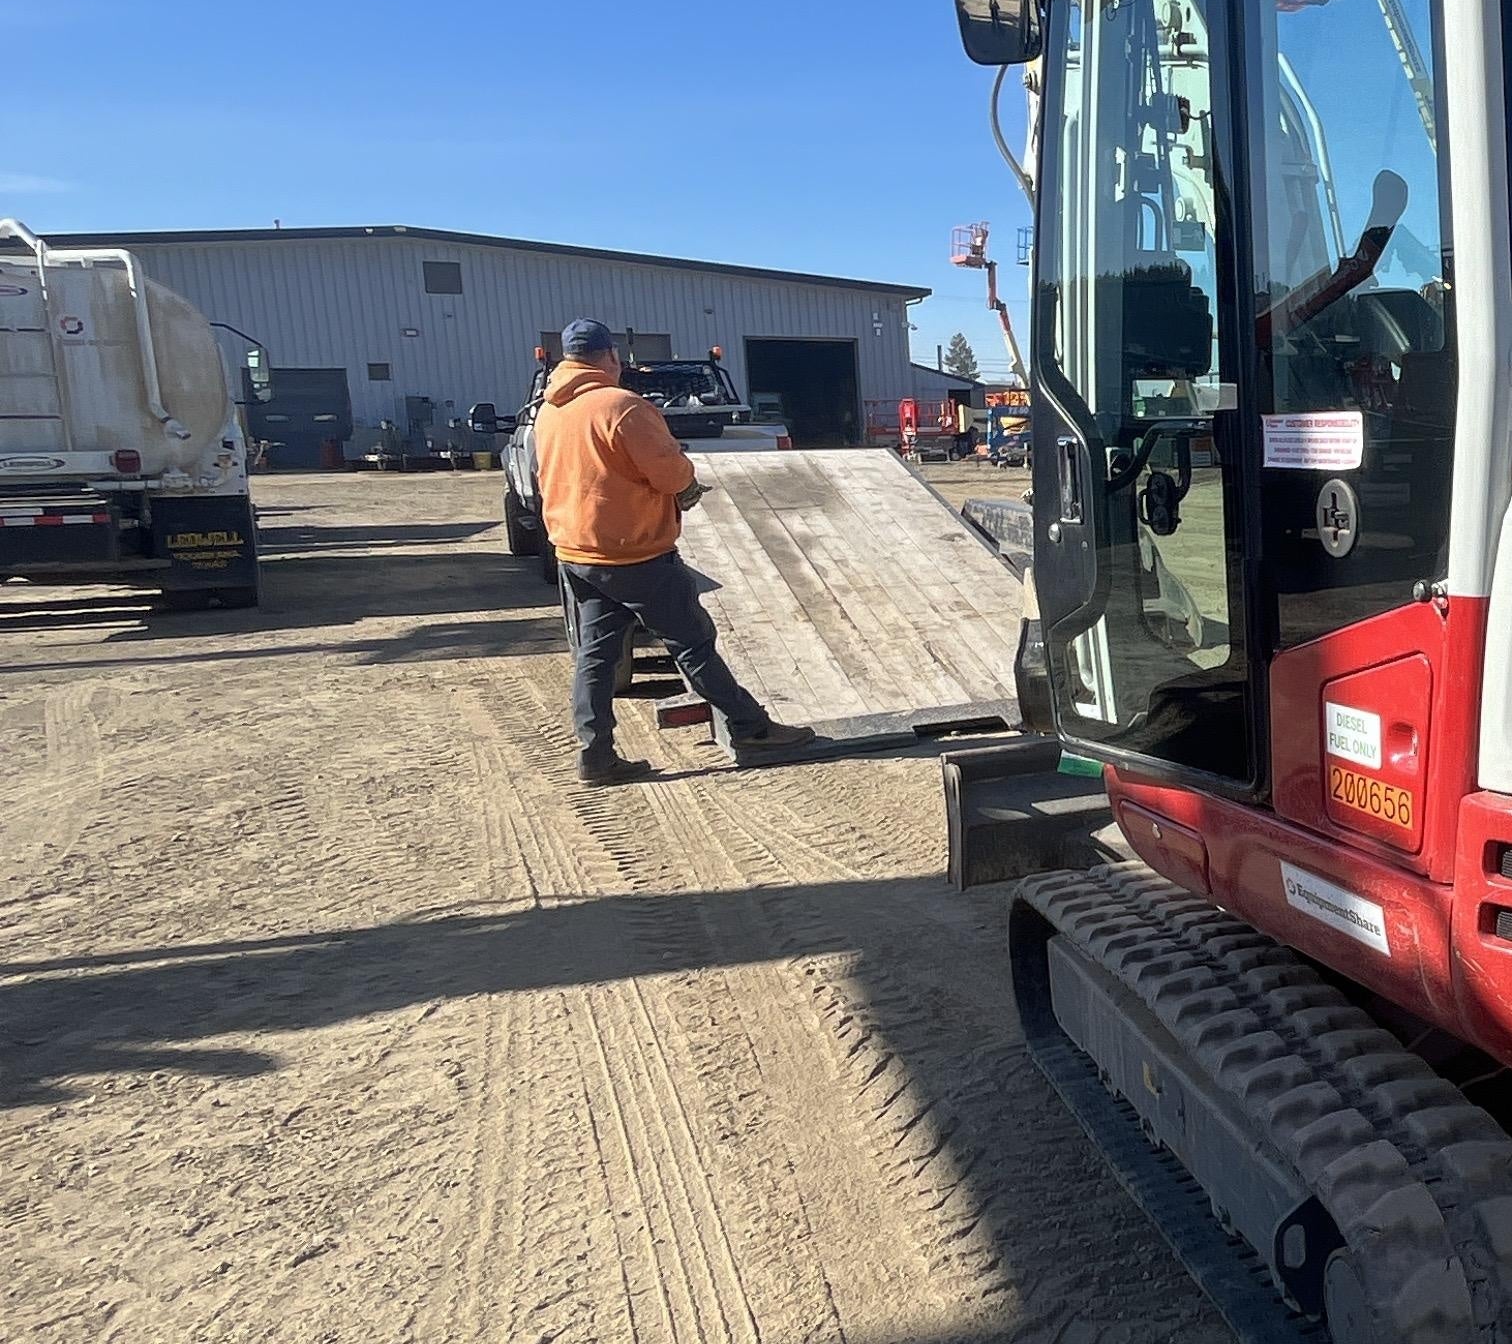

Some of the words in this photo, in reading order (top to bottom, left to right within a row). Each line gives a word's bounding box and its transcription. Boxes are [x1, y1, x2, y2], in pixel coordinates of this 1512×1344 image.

[1336, 712, 1368, 735] DIESEL
[1329, 732, 1351, 752] FUEL
[1352, 740, 1377, 760] ONLY
[1332, 767, 1410, 825] 200656
[1296, 882, 1382, 937] EquipmentShare
